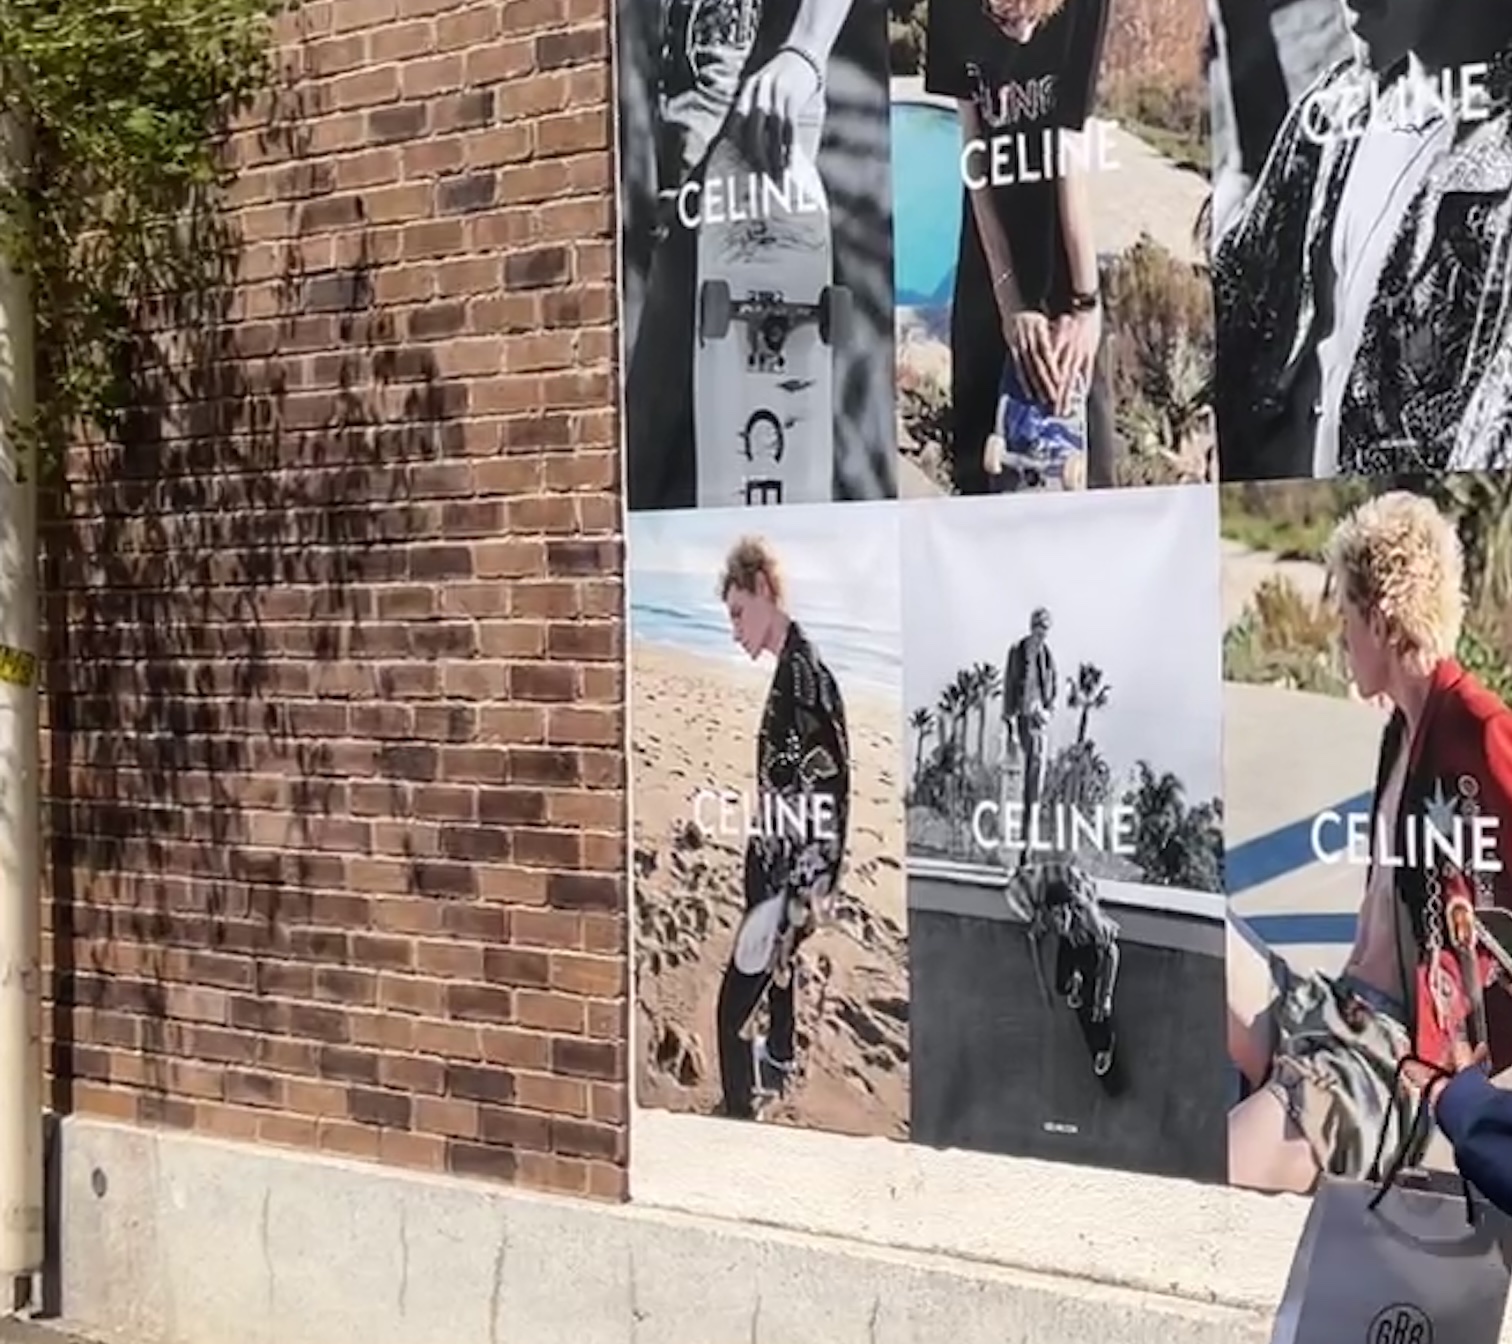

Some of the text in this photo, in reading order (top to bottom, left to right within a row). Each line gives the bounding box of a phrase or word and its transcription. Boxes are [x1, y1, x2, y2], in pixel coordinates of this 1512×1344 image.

[1301, 61, 1490, 144] CELINE
[960, 115, 1121, 190] CELINE
[677, 168, 819, 229] CELINE
[694, 788, 838, 840] CELINE
[972, 800, 1137, 854] CELINE
[1310, 809, 1504, 872] CELINE
